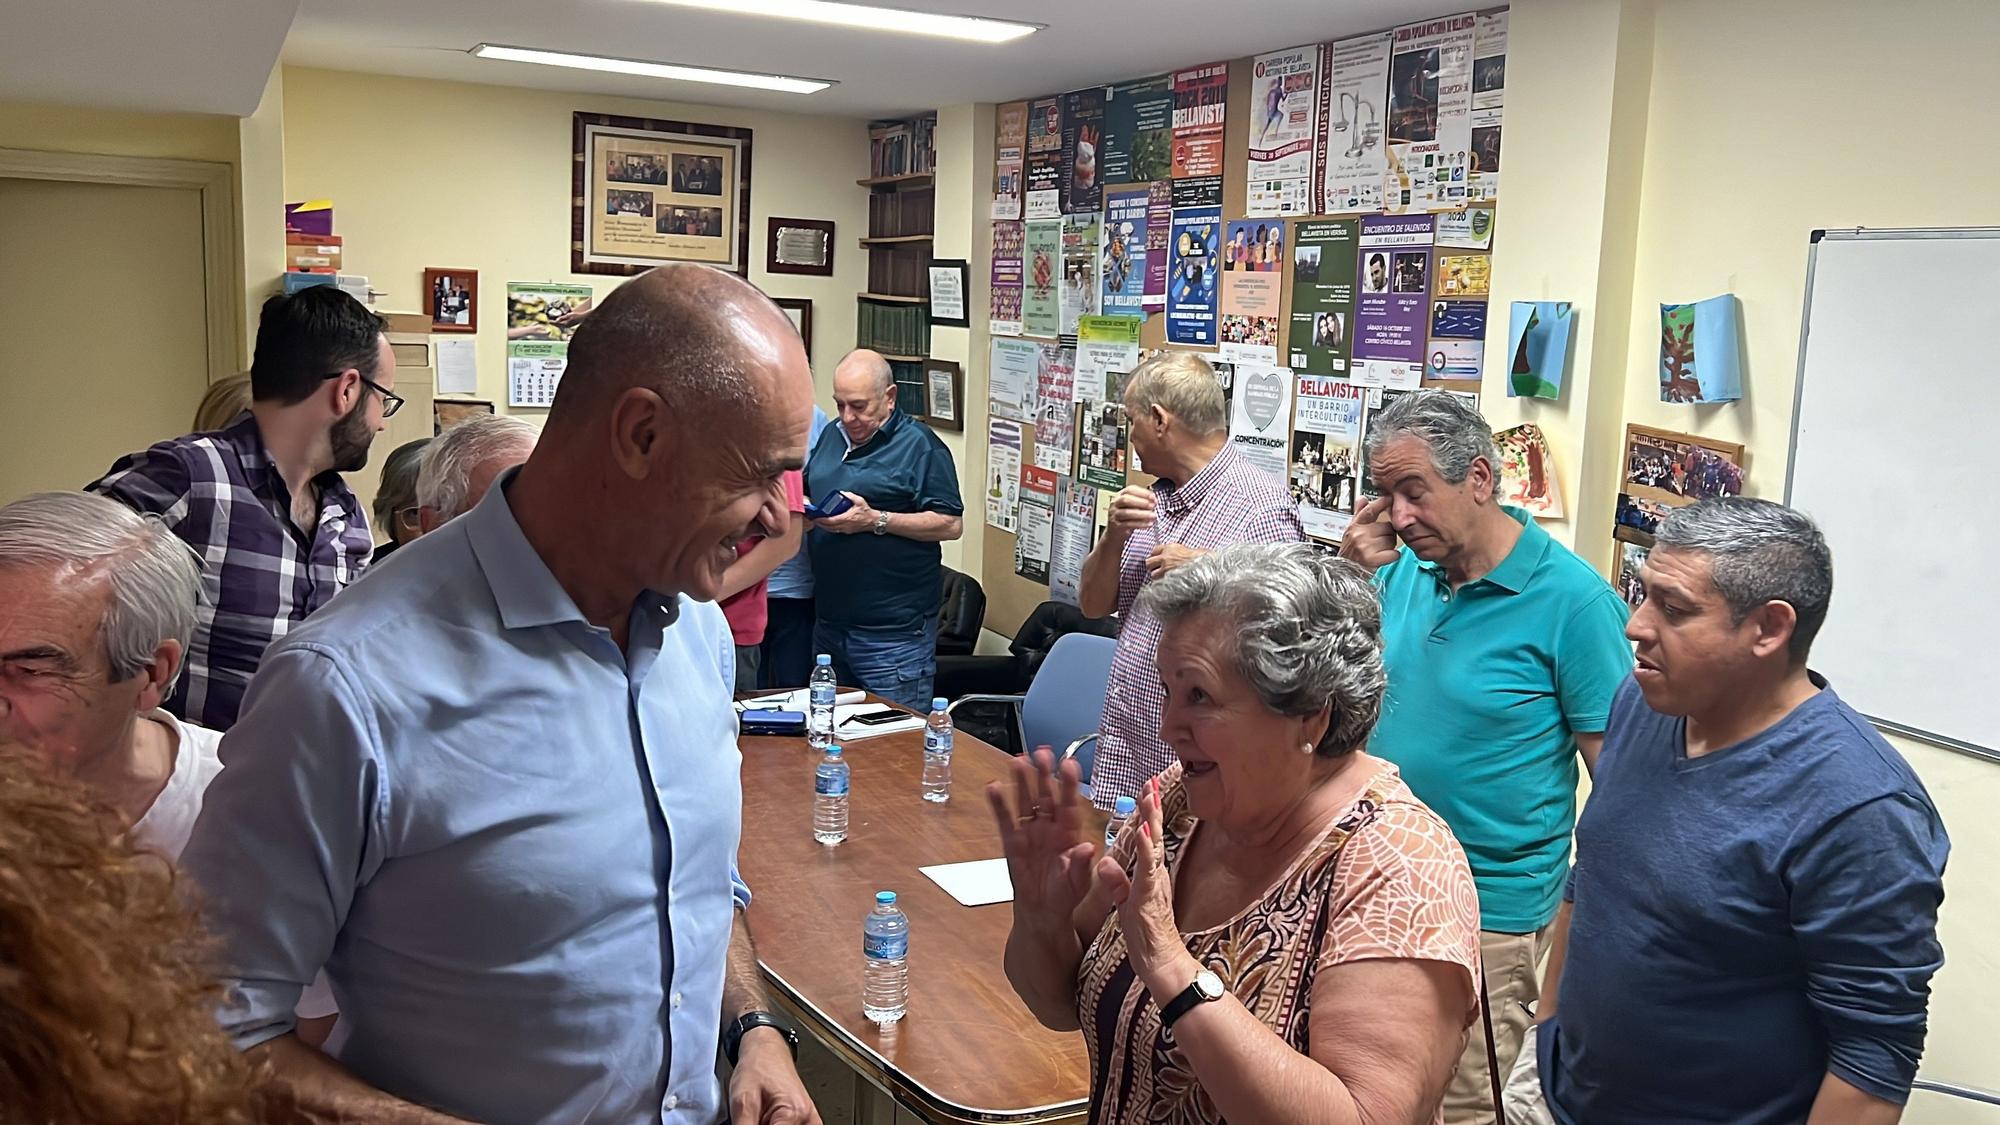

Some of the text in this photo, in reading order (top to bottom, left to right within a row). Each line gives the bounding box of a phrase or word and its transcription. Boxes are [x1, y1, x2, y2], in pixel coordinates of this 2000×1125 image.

[1283, 54, 1302, 64] POPULAR
[1282, 66, 1289, 74] DE
[1289, 63, 1311, 74] BELLAVISTA
[1319, 76, 1331, 137] JUSTICIA
[1172, 103, 1225, 129] BELLAVISTA
[1250, 150, 1267, 160] VIERNES
[1317, 140, 1327, 168] SOS
[1111, 208, 1145, 220] EN TU BARRIO
[1448, 212, 1466, 222] 2020
[1363, 224, 1396, 234] ENCUENTRO
[1395, 224, 1404, 233] DE
[1404, 223, 1430, 233] TALENTOS
[1104, 295, 1142, 307] SOY BELLAVIST
[1300, 379, 1359, 400] BELLAVISTA
[1307, 400, 1349, 412] UN BARRIO
[1297, 410, 1358, 425] INTERCULTURAL
[1234, 435, 1285, 448] CONCENTRACIÓN
[1081, 495, 1093, 508] LA
